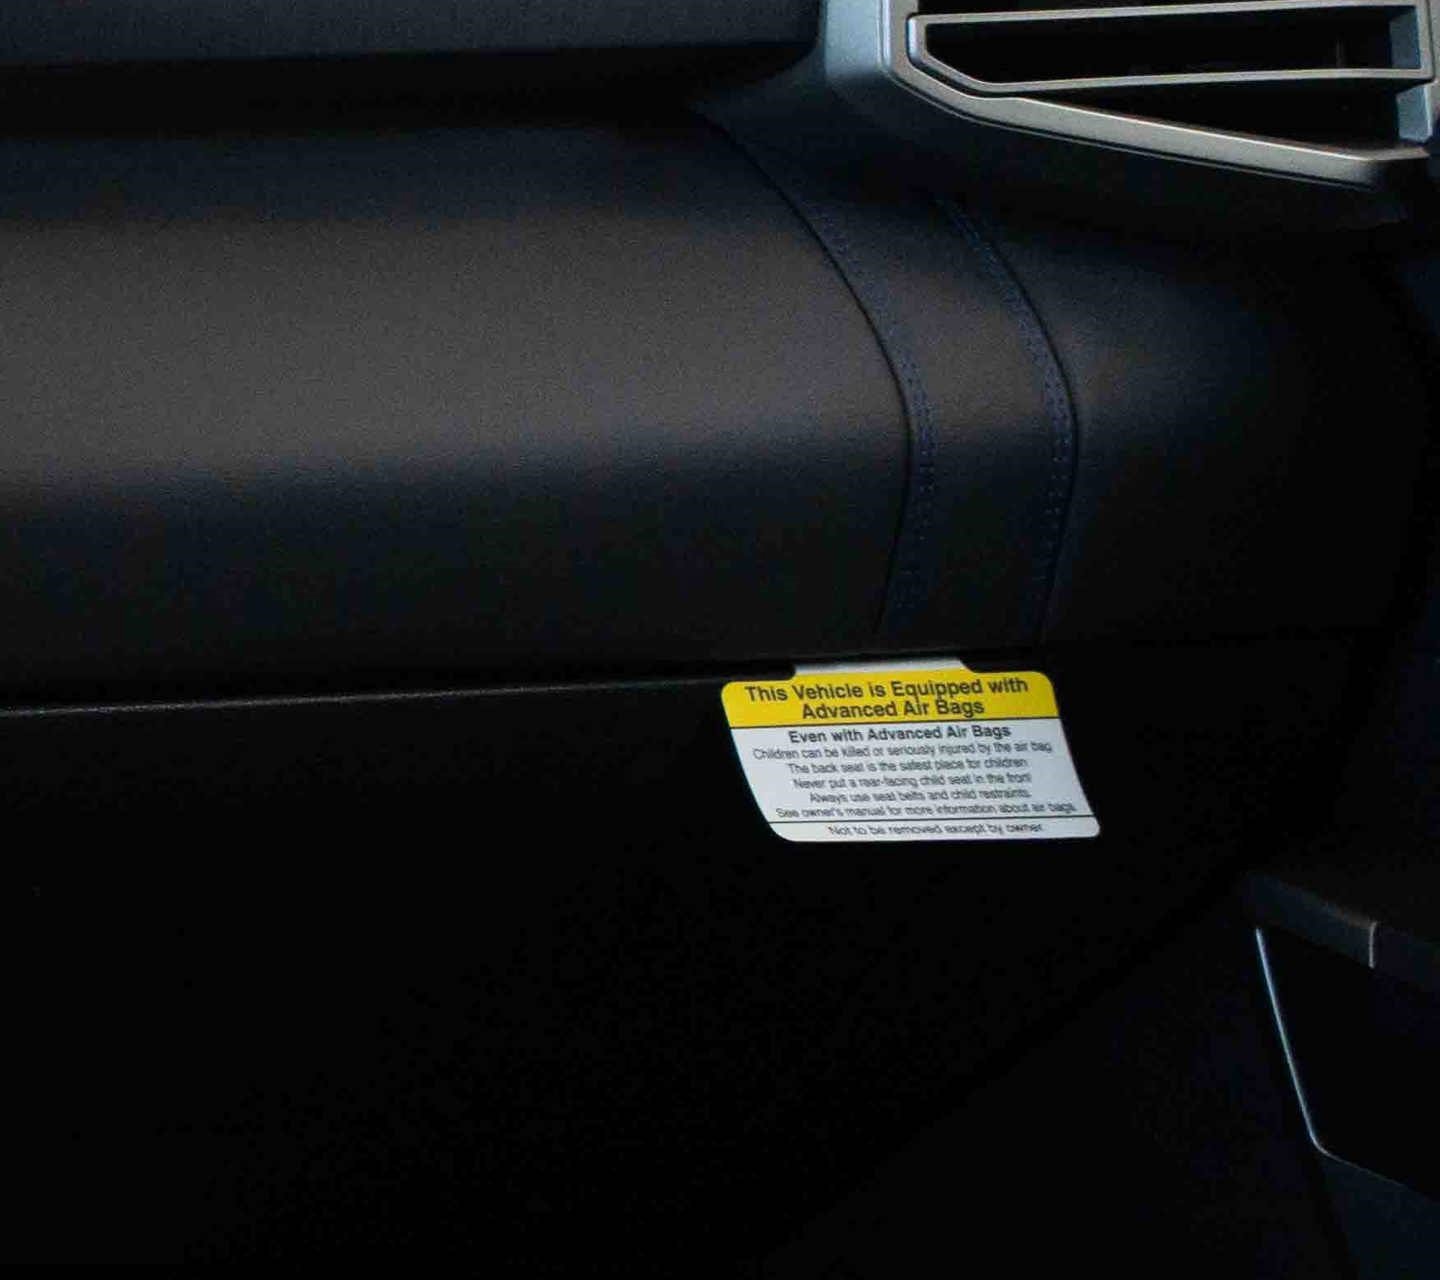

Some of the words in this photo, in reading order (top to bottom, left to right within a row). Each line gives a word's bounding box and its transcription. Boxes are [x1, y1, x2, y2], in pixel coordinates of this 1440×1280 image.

[744, 685, 789, 702] This
[791, 683, 864, 701] Vehicle
[869, 682, 887, 698] is
[891, 679, 983, 701] Equipped
[987, 676, 1029, 693] with
[802, 701, 899, 720] Advanced
[903, 699, 930, 716] Air
[936, 698, 986, 719] Bags
[788, 730, 828, 744] Even
[831, 728, 864, 742] with
[867, 726, 942, 741] Advanced
[946, 725, 968, 738] Air
[971, 724, 1012, 740] Bags
[752, 748, 799, 760] Children
[801, 749, 822, 759] can
[824, 747, 839, 758] be
[841, 746, 870, 758] killed
[872, 747, 884, 757] or
[886, 743, 935, 756] seriously
[937, 742, 974, 756] injured
[977, 742, 991, 755] by
[993, 741, 1012, 752] the
[1014, 741, 1028, 751] air
[788, 763, 810, 774] The
[811, 762, 838, 773] back
[840, 762, 864, 773] seat
[867, 762, 877, 772] is
[879, 761, 897, 771] the
[899, 759, 931, 771] safest
[934, 759, 964, 771] place
[966, 758, 981, 769] for
[793, 778, 825, 789] Never
[828, 778, 846, 789] put
[848, 779, 857, 788] a
[858, 775, 919, 789] rear-facing
[920, 774, 945, 785] child
[947, 774, 971, 785] seat
[973, 773, 985, 784] in
[986, 773, 1005, 784] the
[809, 792, 848, 804] Always
[849, 793, 870, 802] use
[872, 792, 896, 802] seat
[927, 790, 949, 800] and
[950, 789, 976, 799] child
[776, 808, 800, 818] See
[801, 807, 843, 817] owner's
[845, 806, 886, 817] manual
[887, 806, 902, 816] for
[904, 805, 934, 815] more
[936, 803, 997, 814] information
[999, 802, 1031, 813] about
[1032, 802, 1045, 812] air
[828, 825, 851, 836] Not
[853, 825, 867, 835] to
[868, 825, 886, 835] be
[888, 823, 942, 834] removed
[944, 824, 986, 835] except
[987, 824, 1003, 835] by
